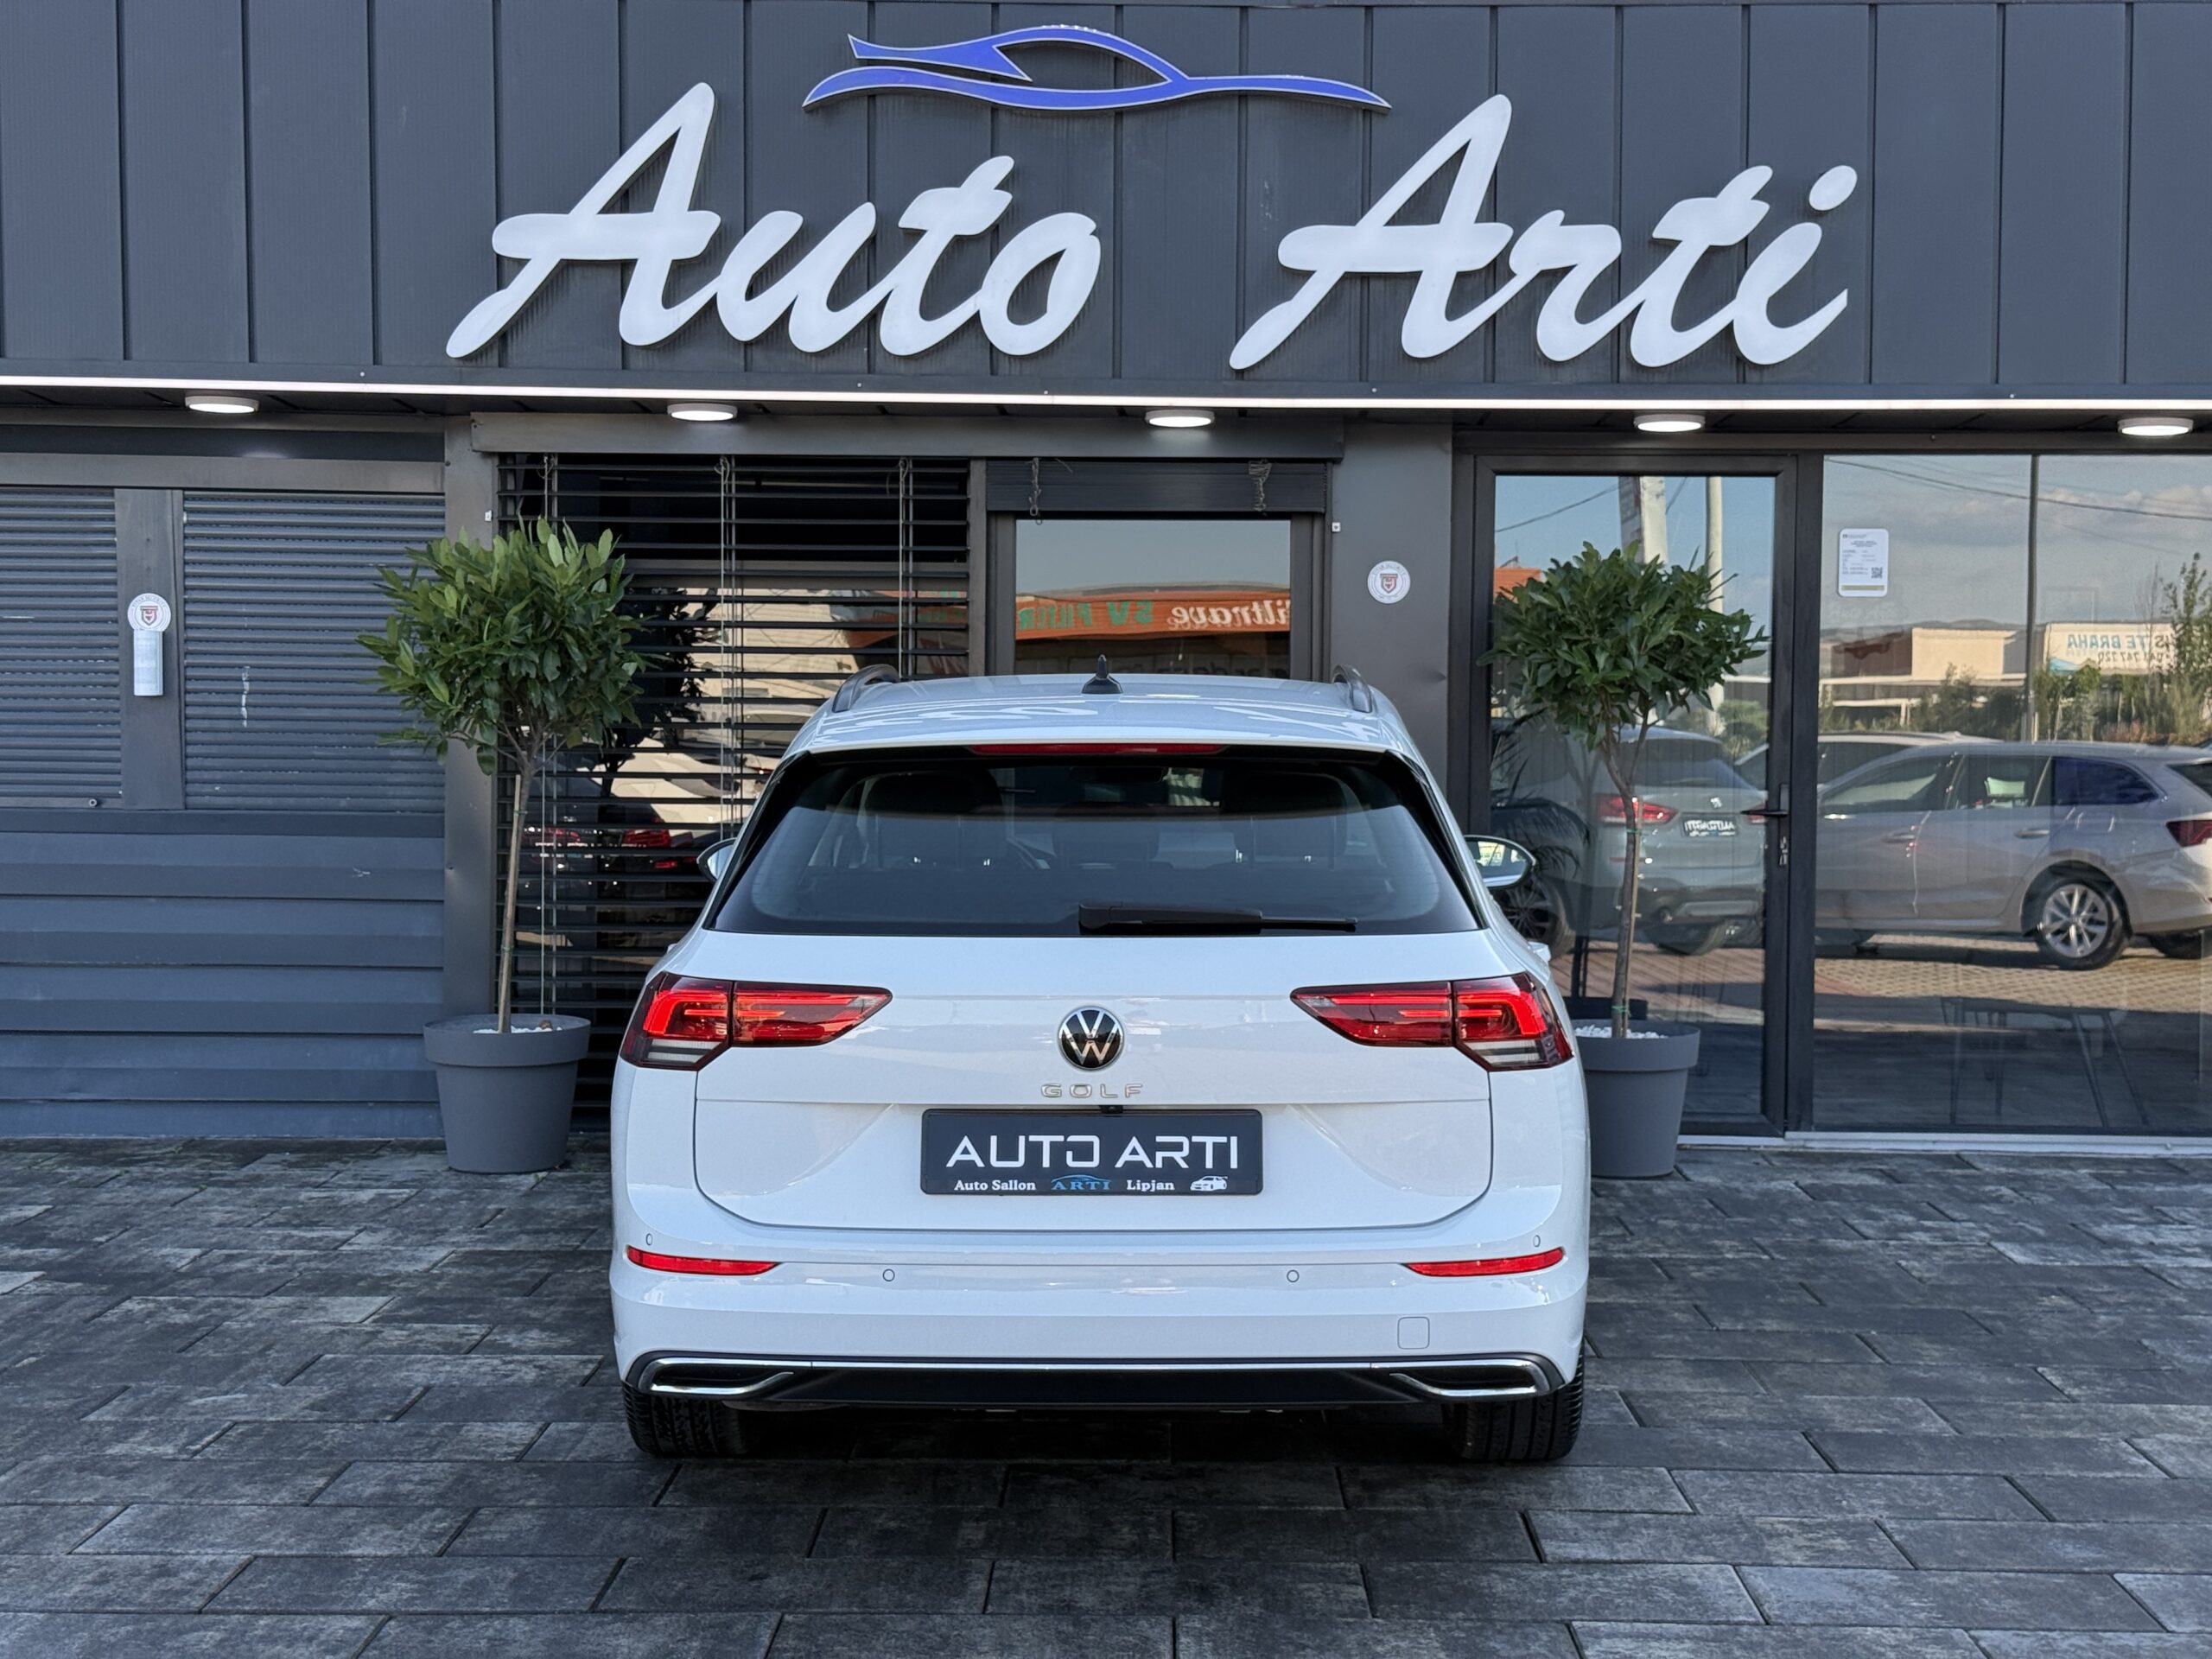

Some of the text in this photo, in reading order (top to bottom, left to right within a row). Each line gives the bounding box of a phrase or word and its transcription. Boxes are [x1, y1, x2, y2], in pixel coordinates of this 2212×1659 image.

[446, 82, 1858, 370] Auto Arti
[1040, 1083, 1143, 1099] GOLF
[946, 1135, 1238, 1169] AUTO ARTI
[953, 1179, 1176, 1192] Auto Sallon ARTI Lipjan
